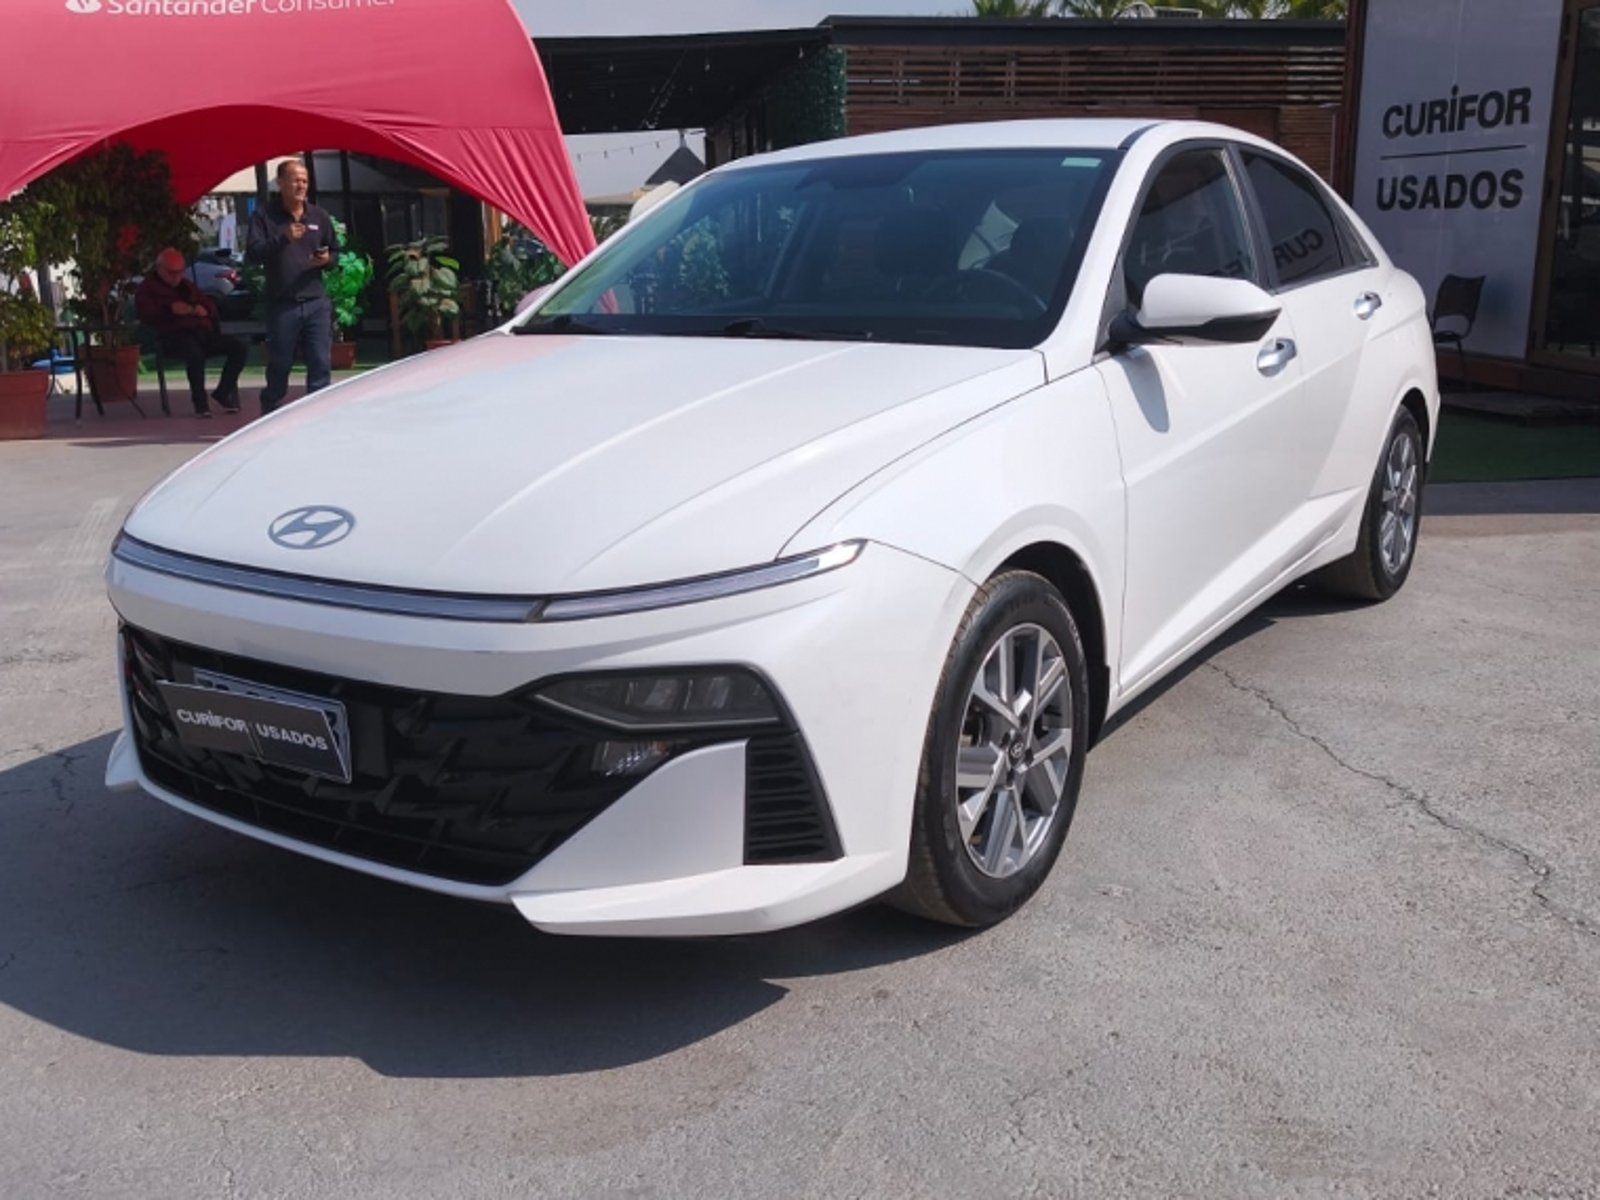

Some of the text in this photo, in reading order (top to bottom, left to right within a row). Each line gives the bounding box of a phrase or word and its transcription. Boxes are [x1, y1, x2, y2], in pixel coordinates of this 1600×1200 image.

[106, 0, 255, 15] Santander
[1376, 168, 1524, 211] USADOS
[256, 722, 328, 750] USADOS
